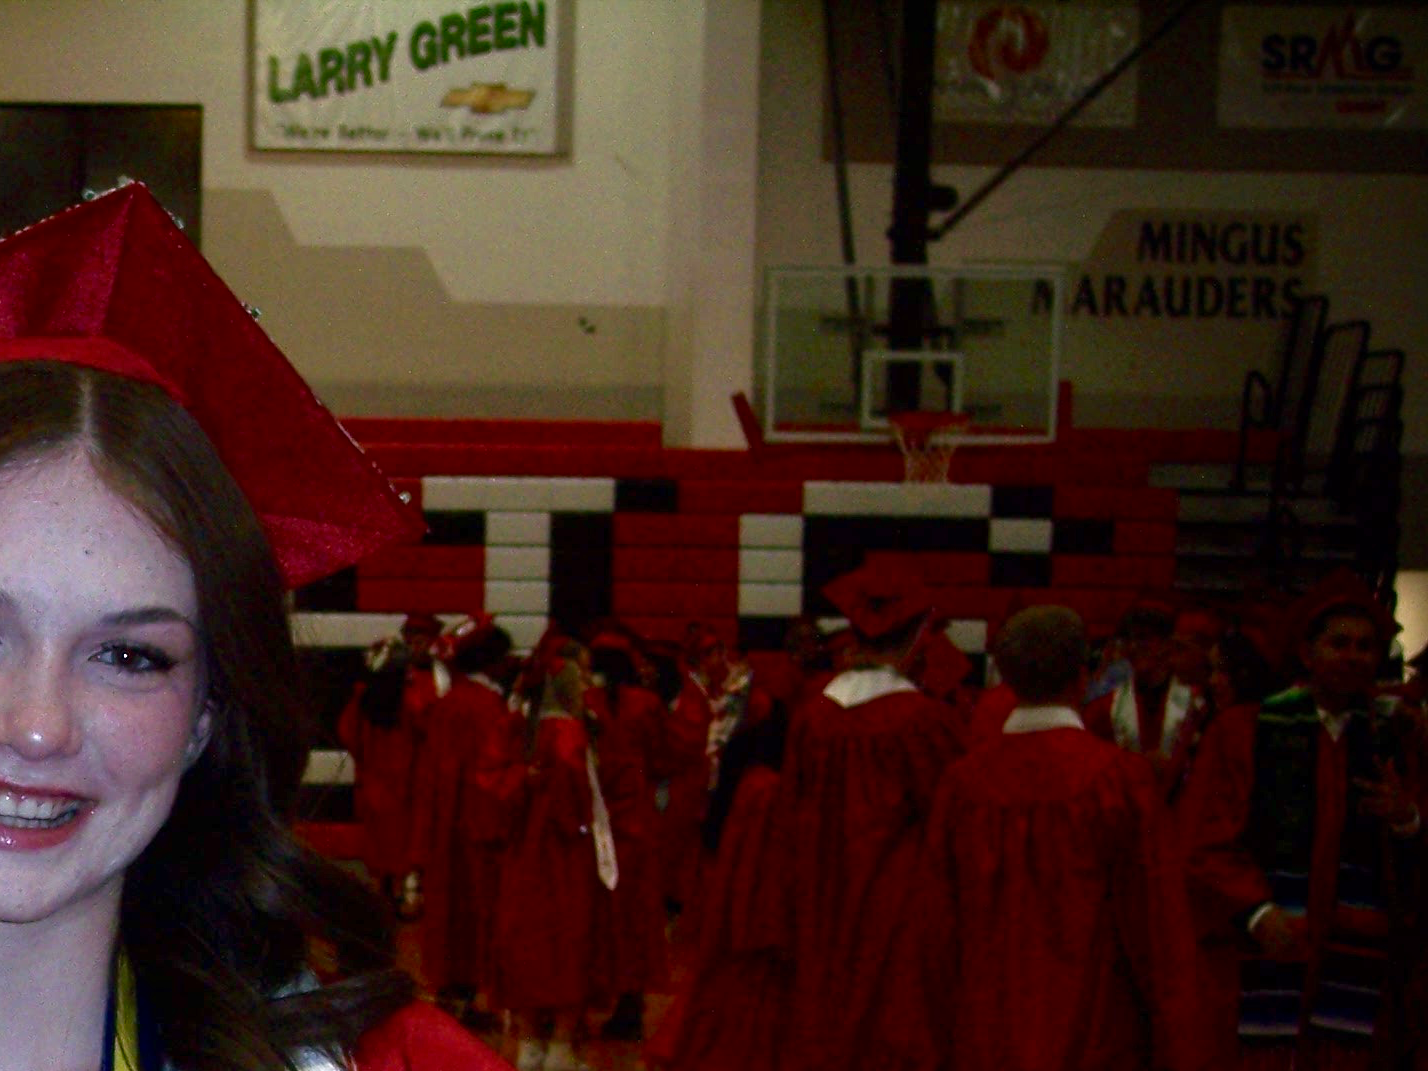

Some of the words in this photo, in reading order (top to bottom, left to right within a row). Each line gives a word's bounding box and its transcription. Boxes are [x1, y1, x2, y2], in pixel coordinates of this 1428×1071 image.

[269, 31, 398, 103] LARRY
[409, 0, 546, 72] GREEN
[1136, 219, 1305, 266] MINGUS
